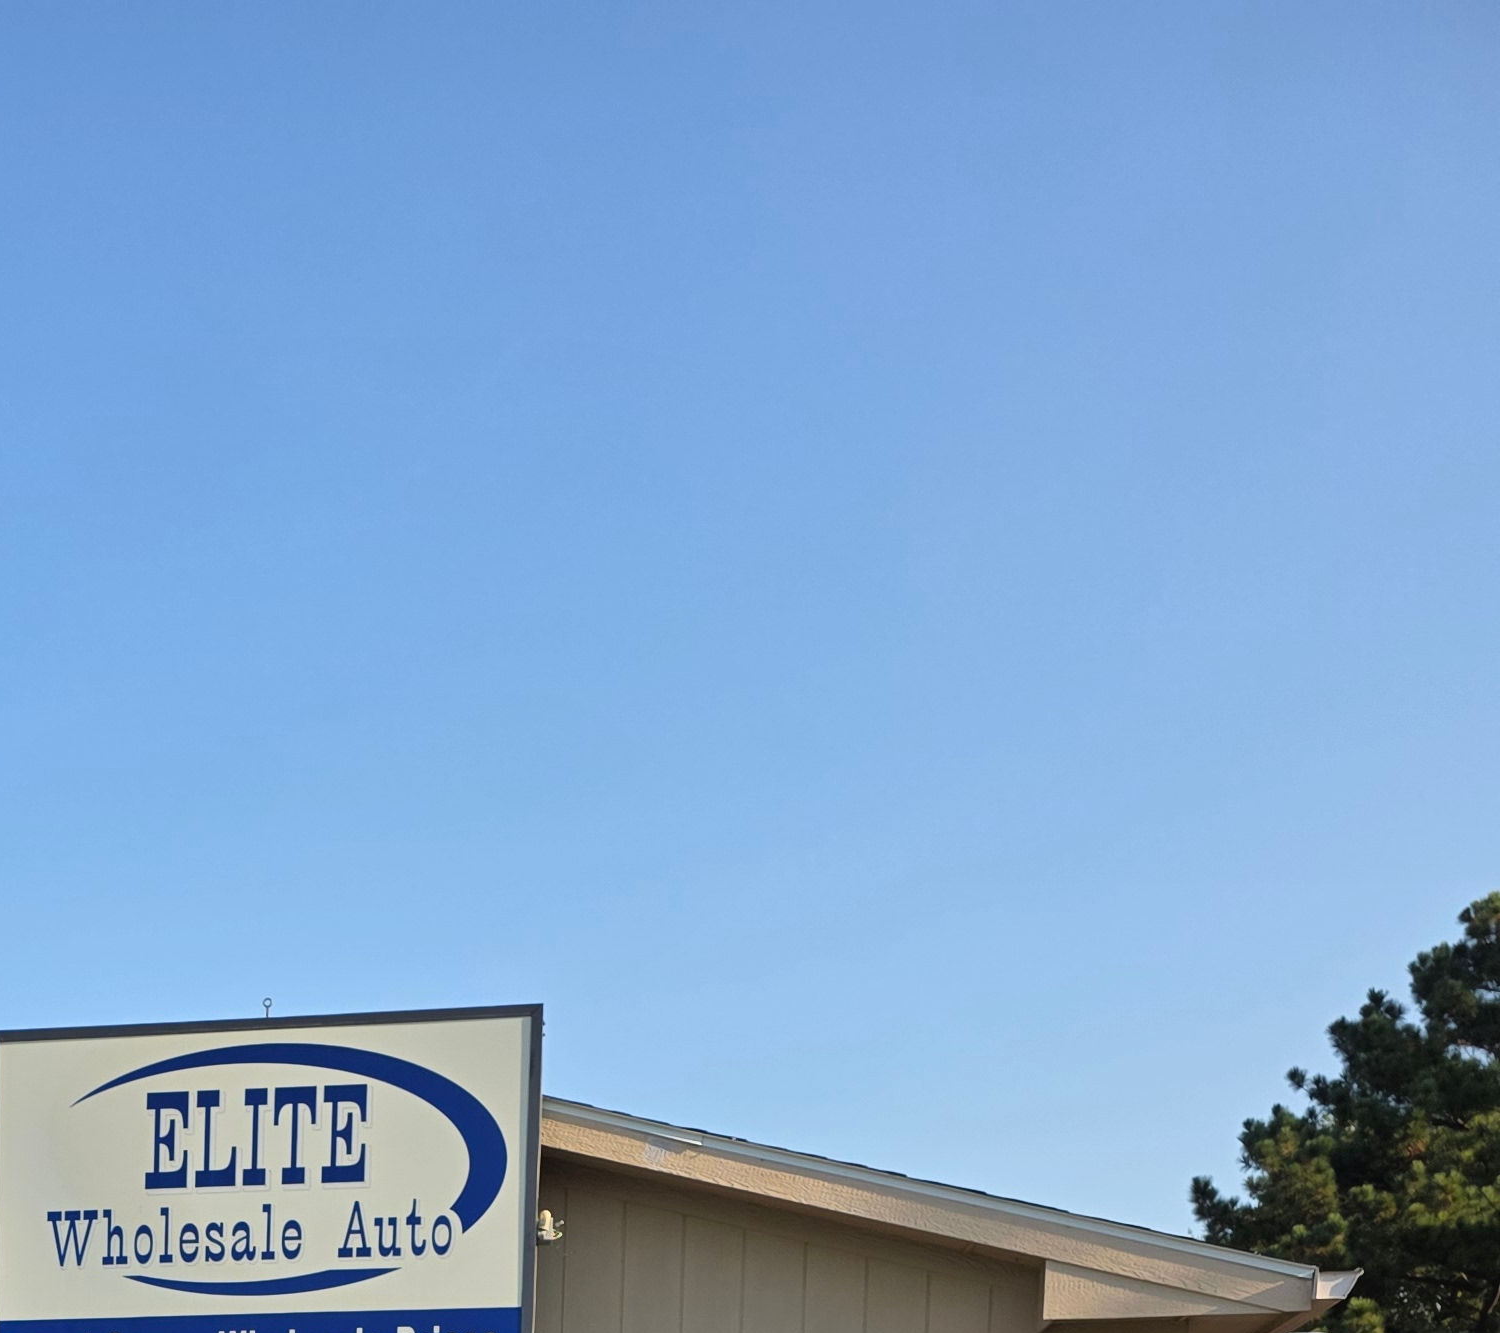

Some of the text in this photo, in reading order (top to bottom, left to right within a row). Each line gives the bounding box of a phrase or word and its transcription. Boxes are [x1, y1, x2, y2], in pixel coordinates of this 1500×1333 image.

[145, 1083, 371, 1190] ELITE
[47, 1199, 454, 1268] Wholesale Auto
